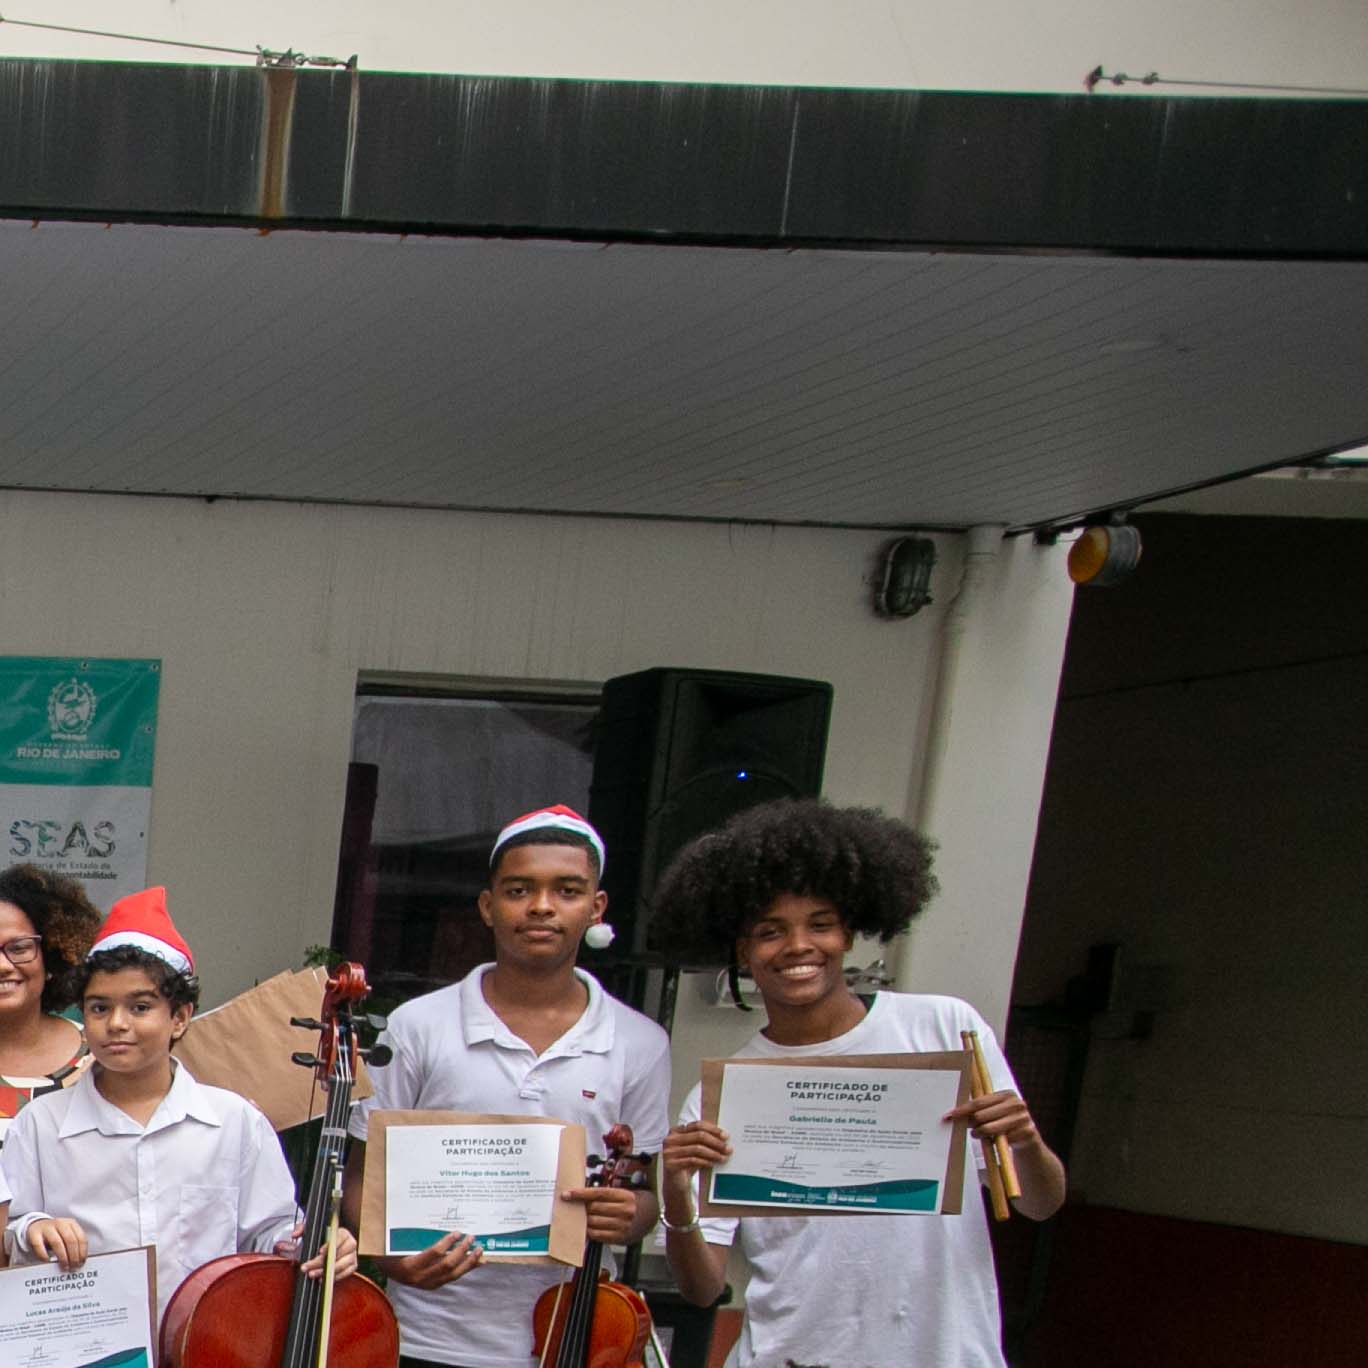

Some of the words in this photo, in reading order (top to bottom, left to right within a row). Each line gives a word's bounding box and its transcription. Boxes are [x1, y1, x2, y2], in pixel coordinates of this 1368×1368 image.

[17, 747, 40, 758] RIO
[43, 748, 60, 758] DE
[62, 749, 120, 759] JANEIRO
[9, 820, 116, 857] SEAS
[786, 1081, 869, 1091] CERTIFICADO
[872, 1084, 888, 1092] DE
[790, 1091, 882, 1103] PARTICIPAÇÃO
[849, 1117, 877, 1125] Paula
[446, 1147, 523, 1157] PARTICIPAÇÃO
[25, 1272, 85, 1287] CERTIFICADO
[87, 1270, 98, 1278] DE
[29, 1280, 95, 1295] PARTICIPAÇÃO
